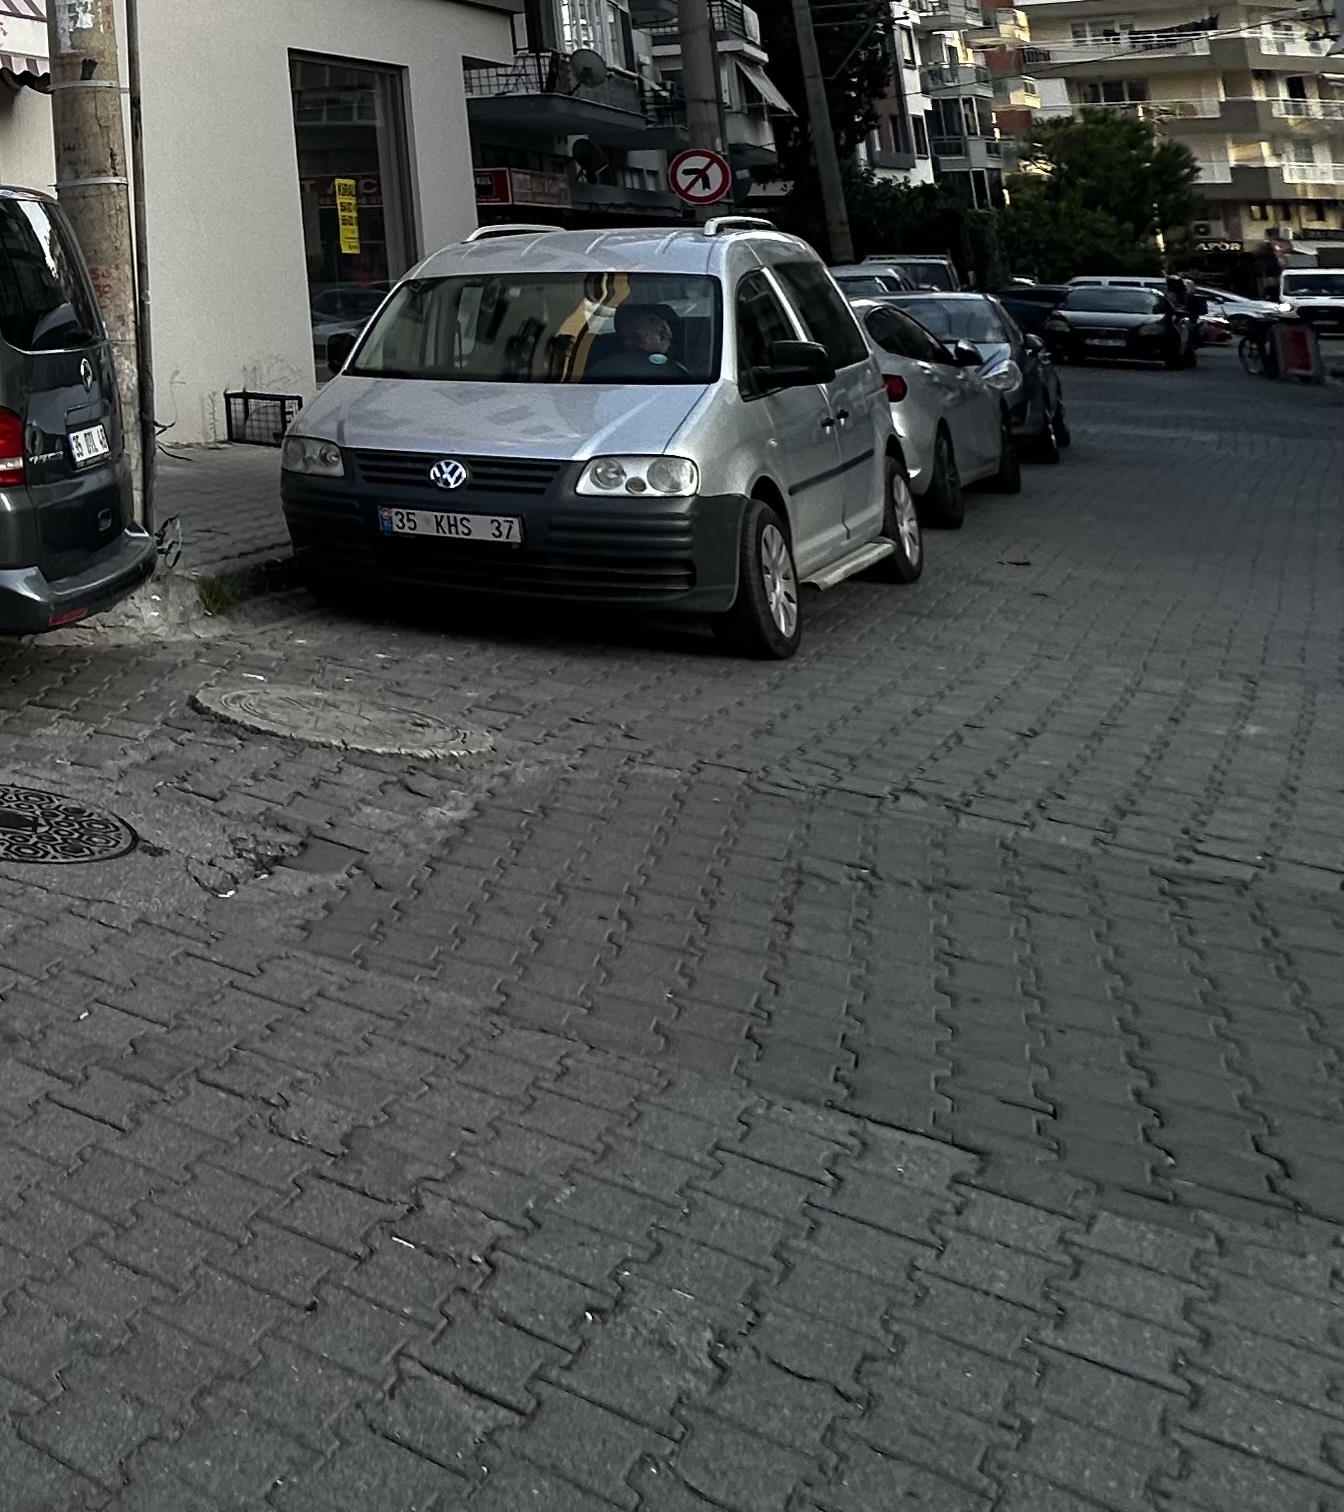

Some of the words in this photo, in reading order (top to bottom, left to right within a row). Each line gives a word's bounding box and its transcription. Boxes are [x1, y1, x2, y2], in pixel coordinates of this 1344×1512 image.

[394, 510, 417, 531] 35
[434, 514, 472, 537] KHS
[490, 519, 514, 539] 37
